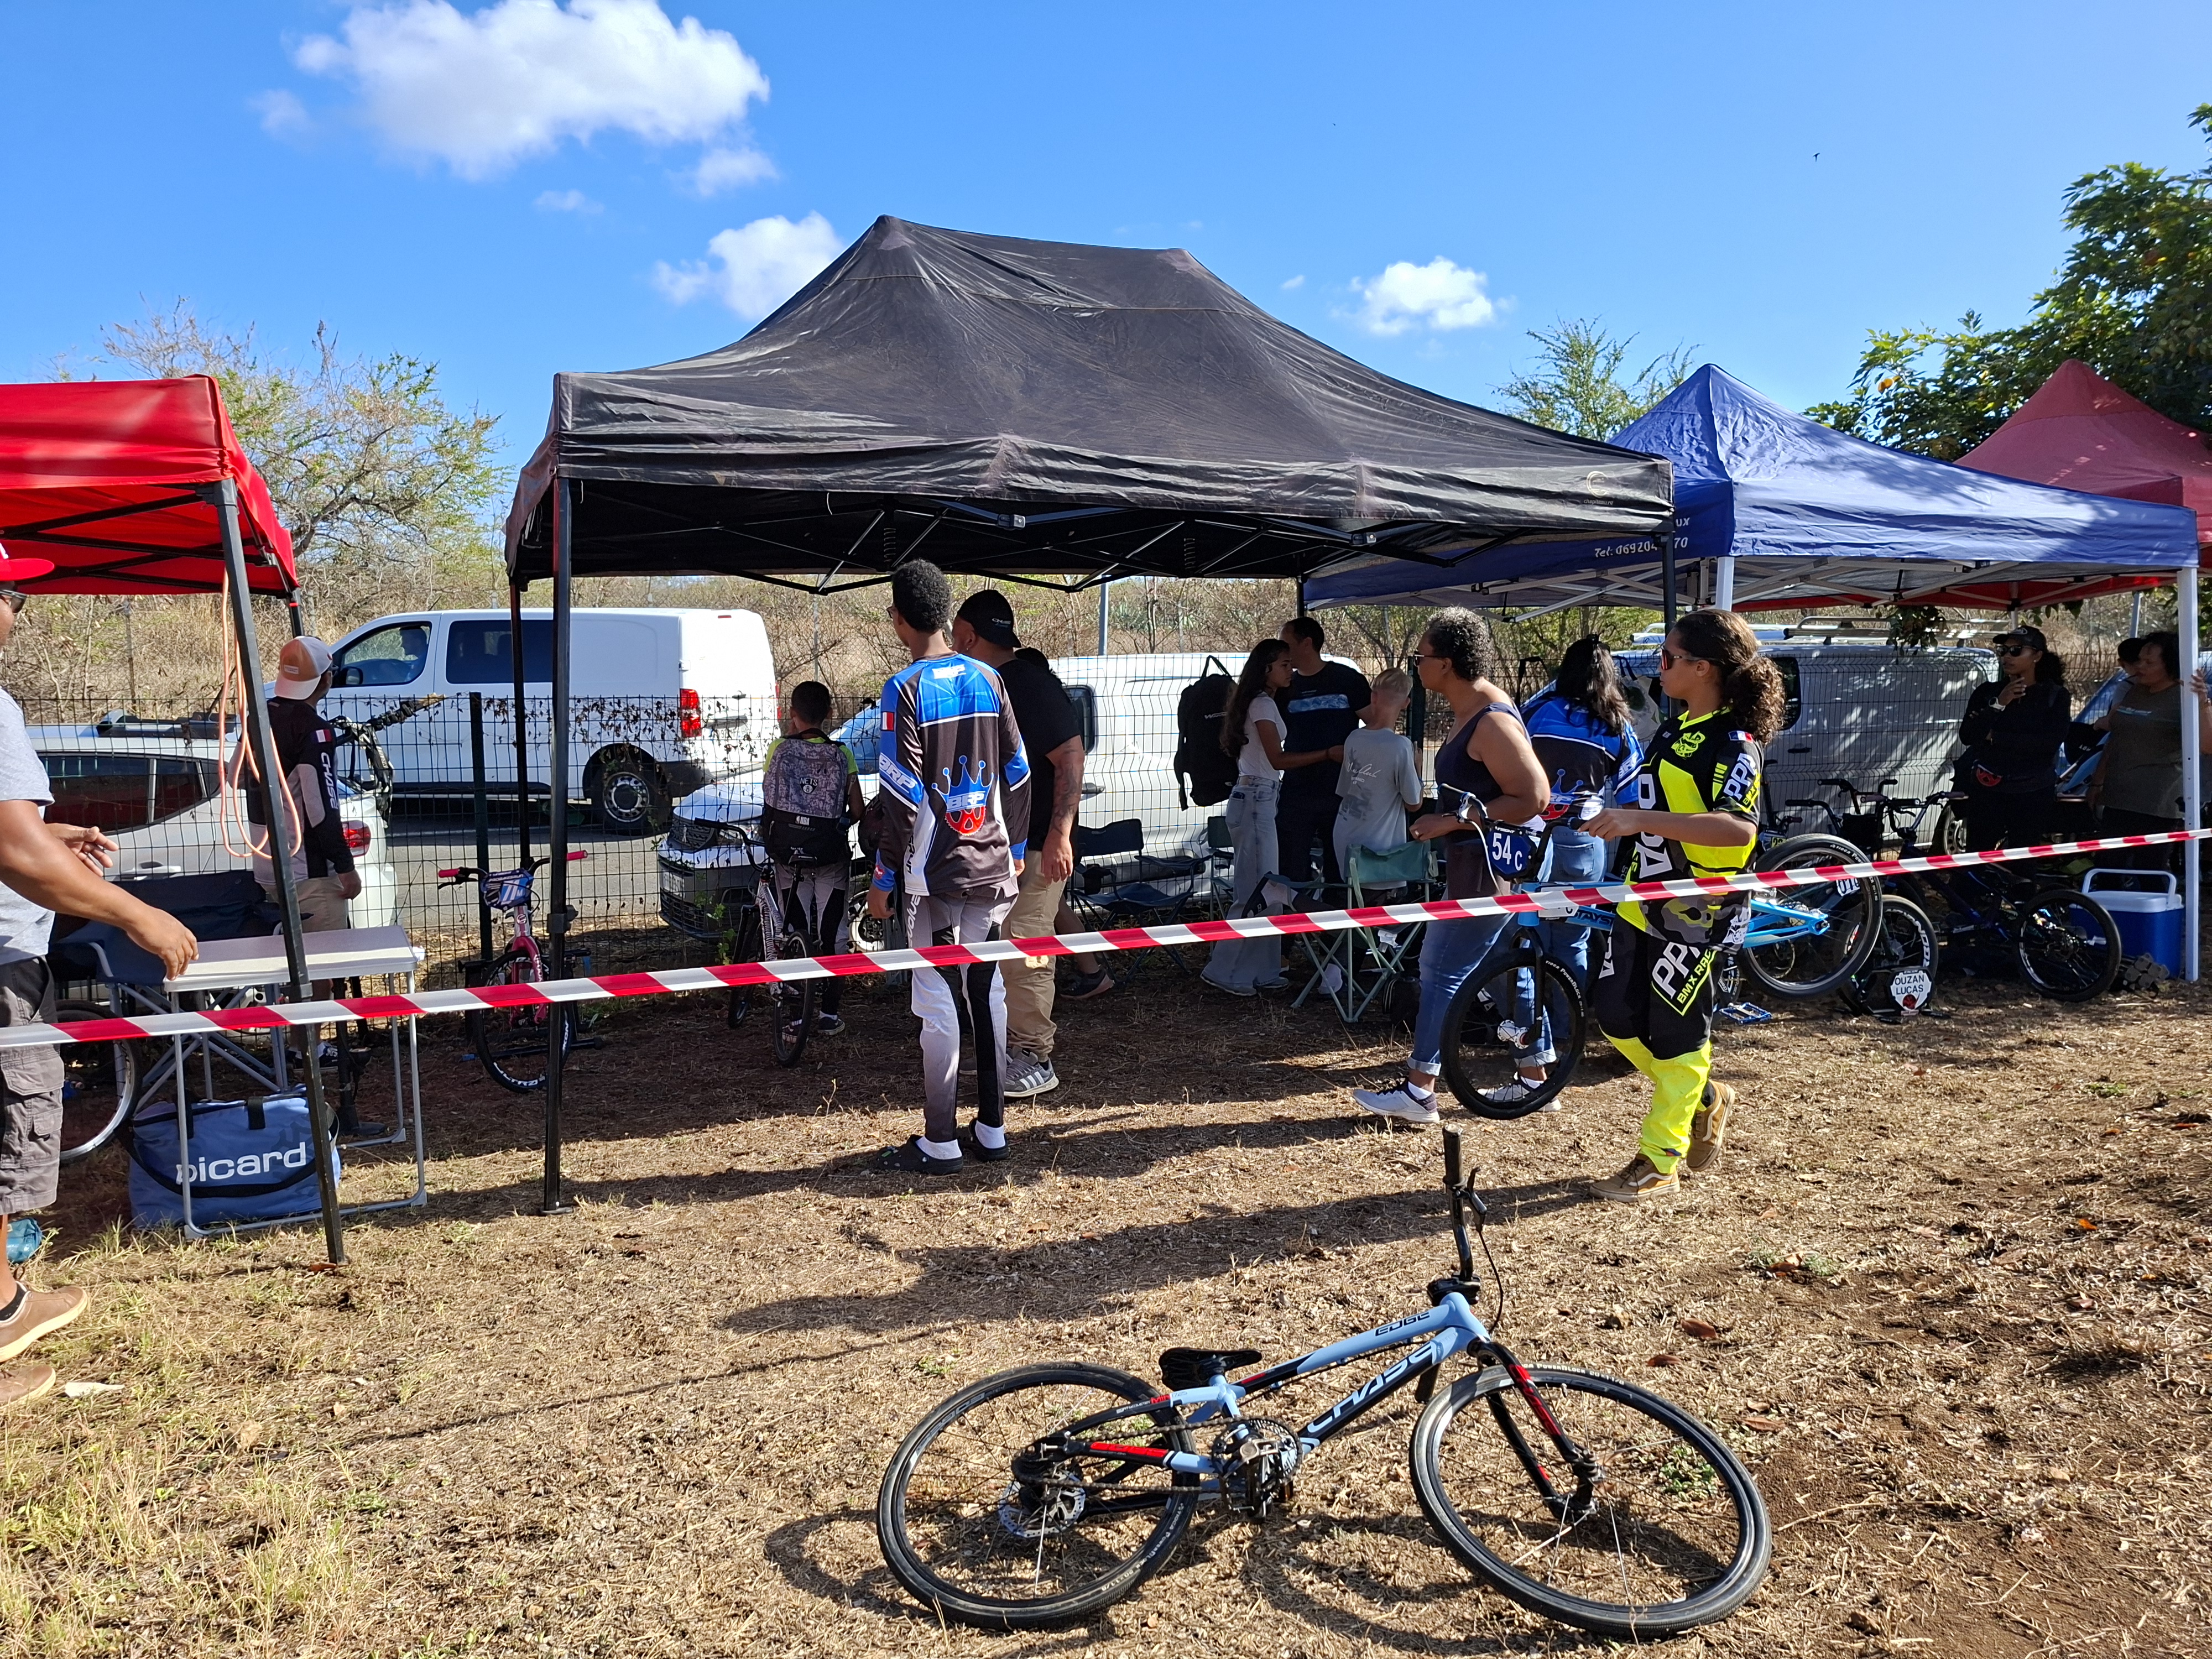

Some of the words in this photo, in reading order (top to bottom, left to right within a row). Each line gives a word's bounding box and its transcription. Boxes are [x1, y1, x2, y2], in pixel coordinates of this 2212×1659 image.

[1615, 537, 1688, 555] 06920470
[321, 752, 339, 809] CHASE
[800, 778, 818, 786] NETS
[880, 756, 917, 788] BRP
[1723, 753, 1756, 801] PPA
[948, 793, 984, 808] BRP
[800, 816, 810, 826] NBA
[1492, 832, 1511, 865] 54
[1515, 851, 1522, 871] C
[1652, 942, 1700, 999] PP
[1677, 974, 1698, 1004] BMX
[1694, 948, 1712, 976] RAC
[1895, 974, 1924, 985] OUZAN
[1896, 984, 1924, 995] LUCAS
[176, 1141, 306, 1185] picard
[1375, 1311, 1430, 1337] EDGE
[1307, 1340, 1437, 1433] CHASE
